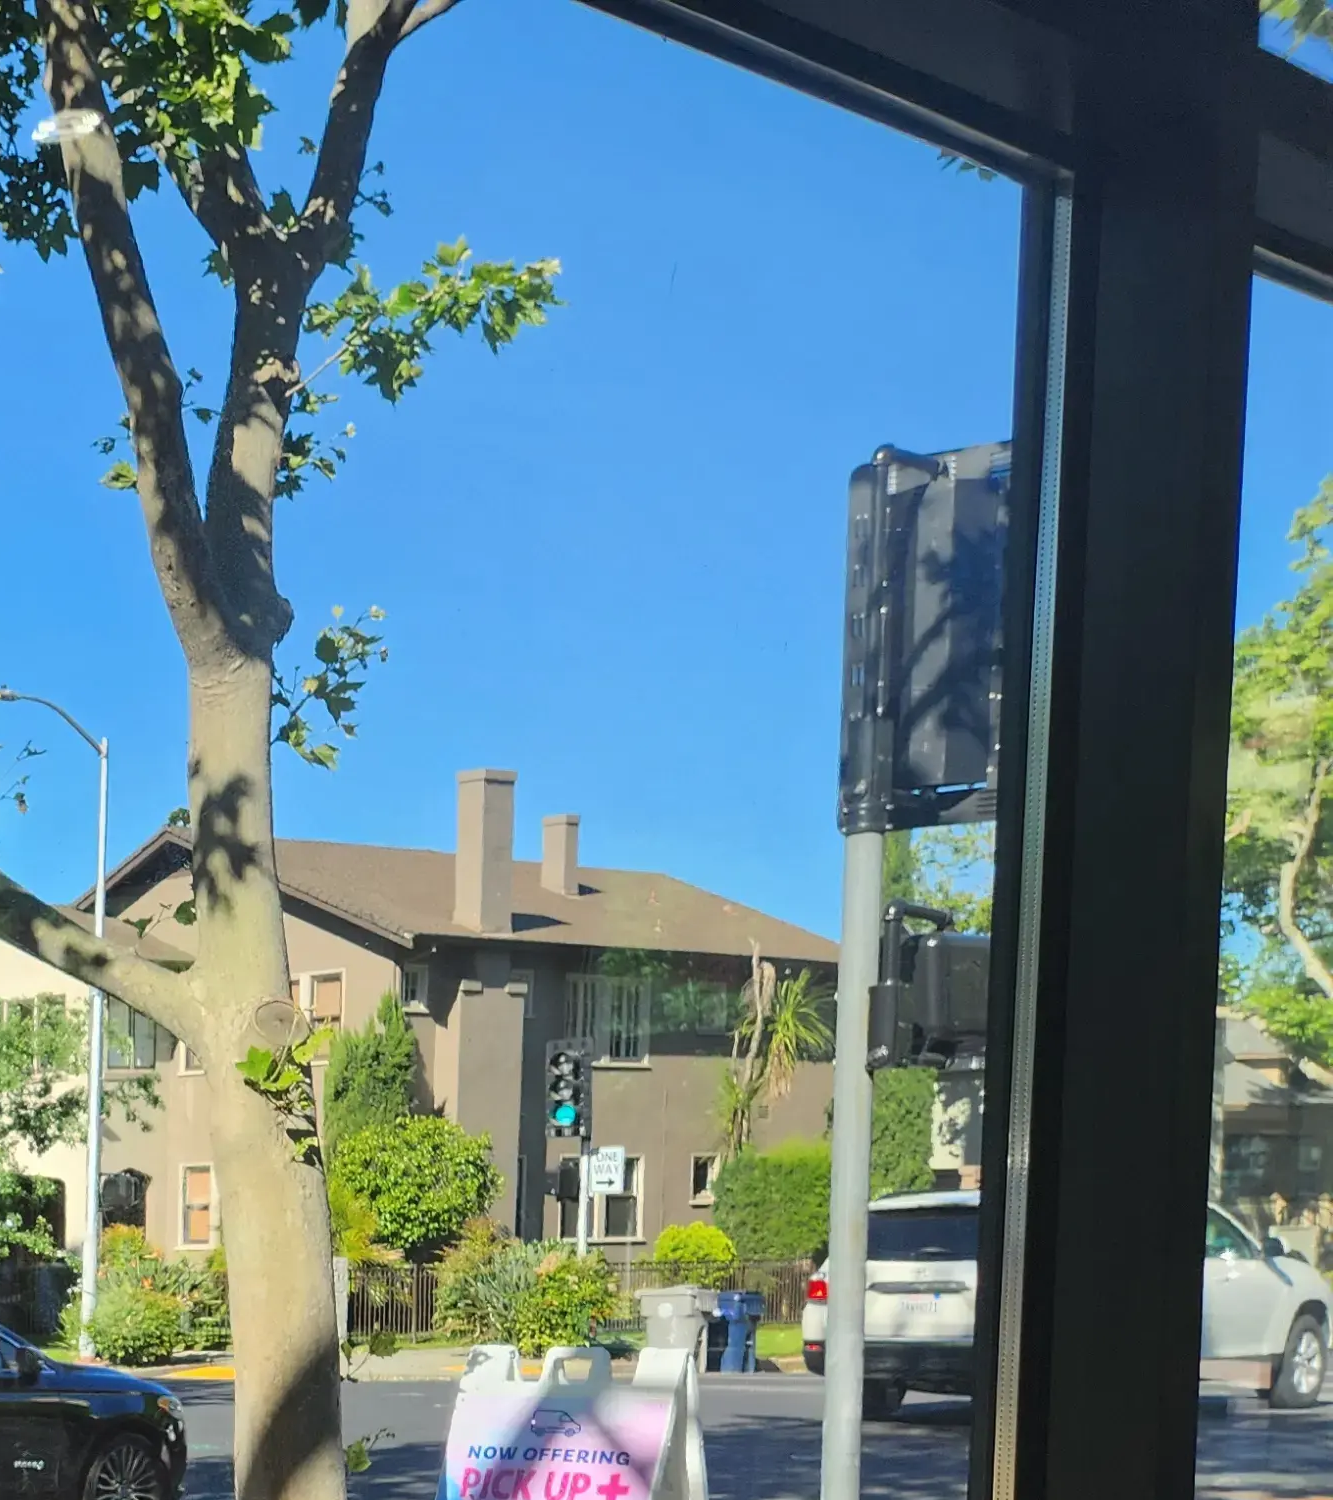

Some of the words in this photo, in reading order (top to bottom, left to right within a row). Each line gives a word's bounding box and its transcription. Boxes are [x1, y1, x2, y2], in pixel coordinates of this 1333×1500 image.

[596, 1151, 618, 1163] ONE
[593, 1163, 621, 1175] WAY
[467, 1445, 518, 1461] NOW
[523, 1447, 631, 1466] OFFERING
[459, 1466, 537, 1500] PICK
